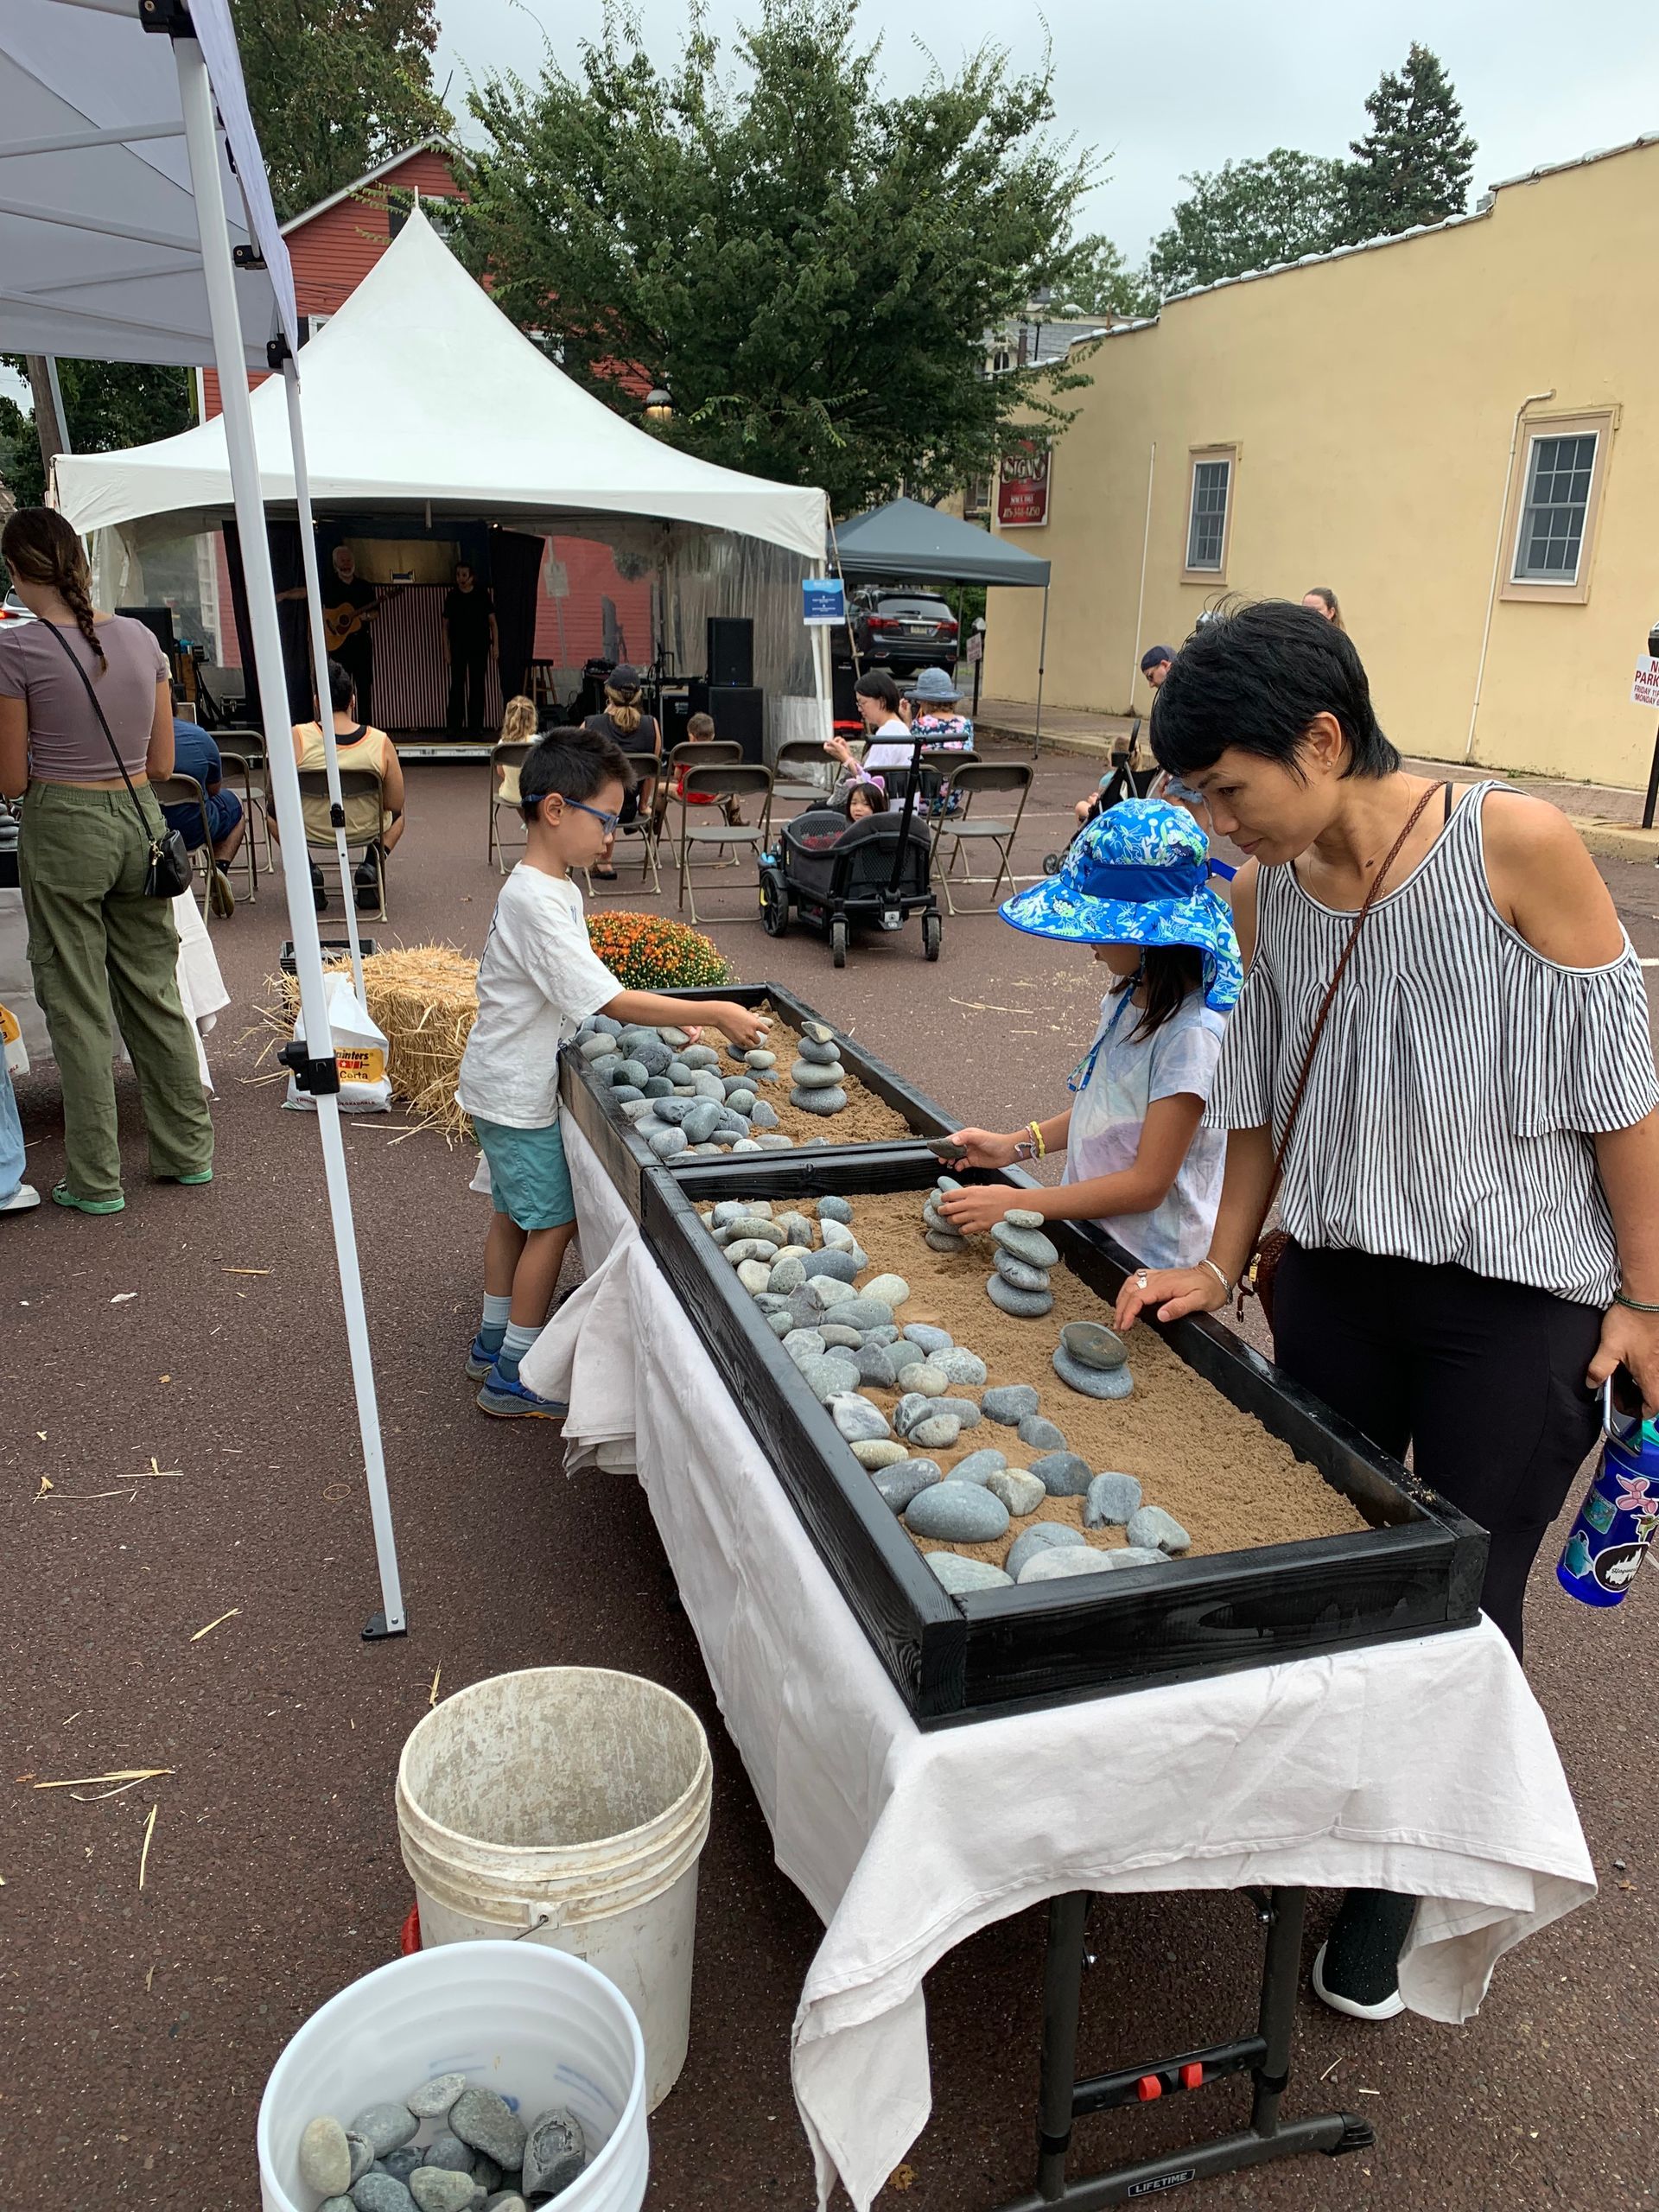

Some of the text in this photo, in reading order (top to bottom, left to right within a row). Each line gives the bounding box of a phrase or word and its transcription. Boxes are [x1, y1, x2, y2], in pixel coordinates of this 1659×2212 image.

[1650, 660, 1659, 672] N
[1634, 684, 1651, 696] FRIDAY
[1634, 694, 1656, 705] MONDAY
[336, 1049, 369, 1060] ainters
[1135, 2172, 1188, 2194] LIFETIME
